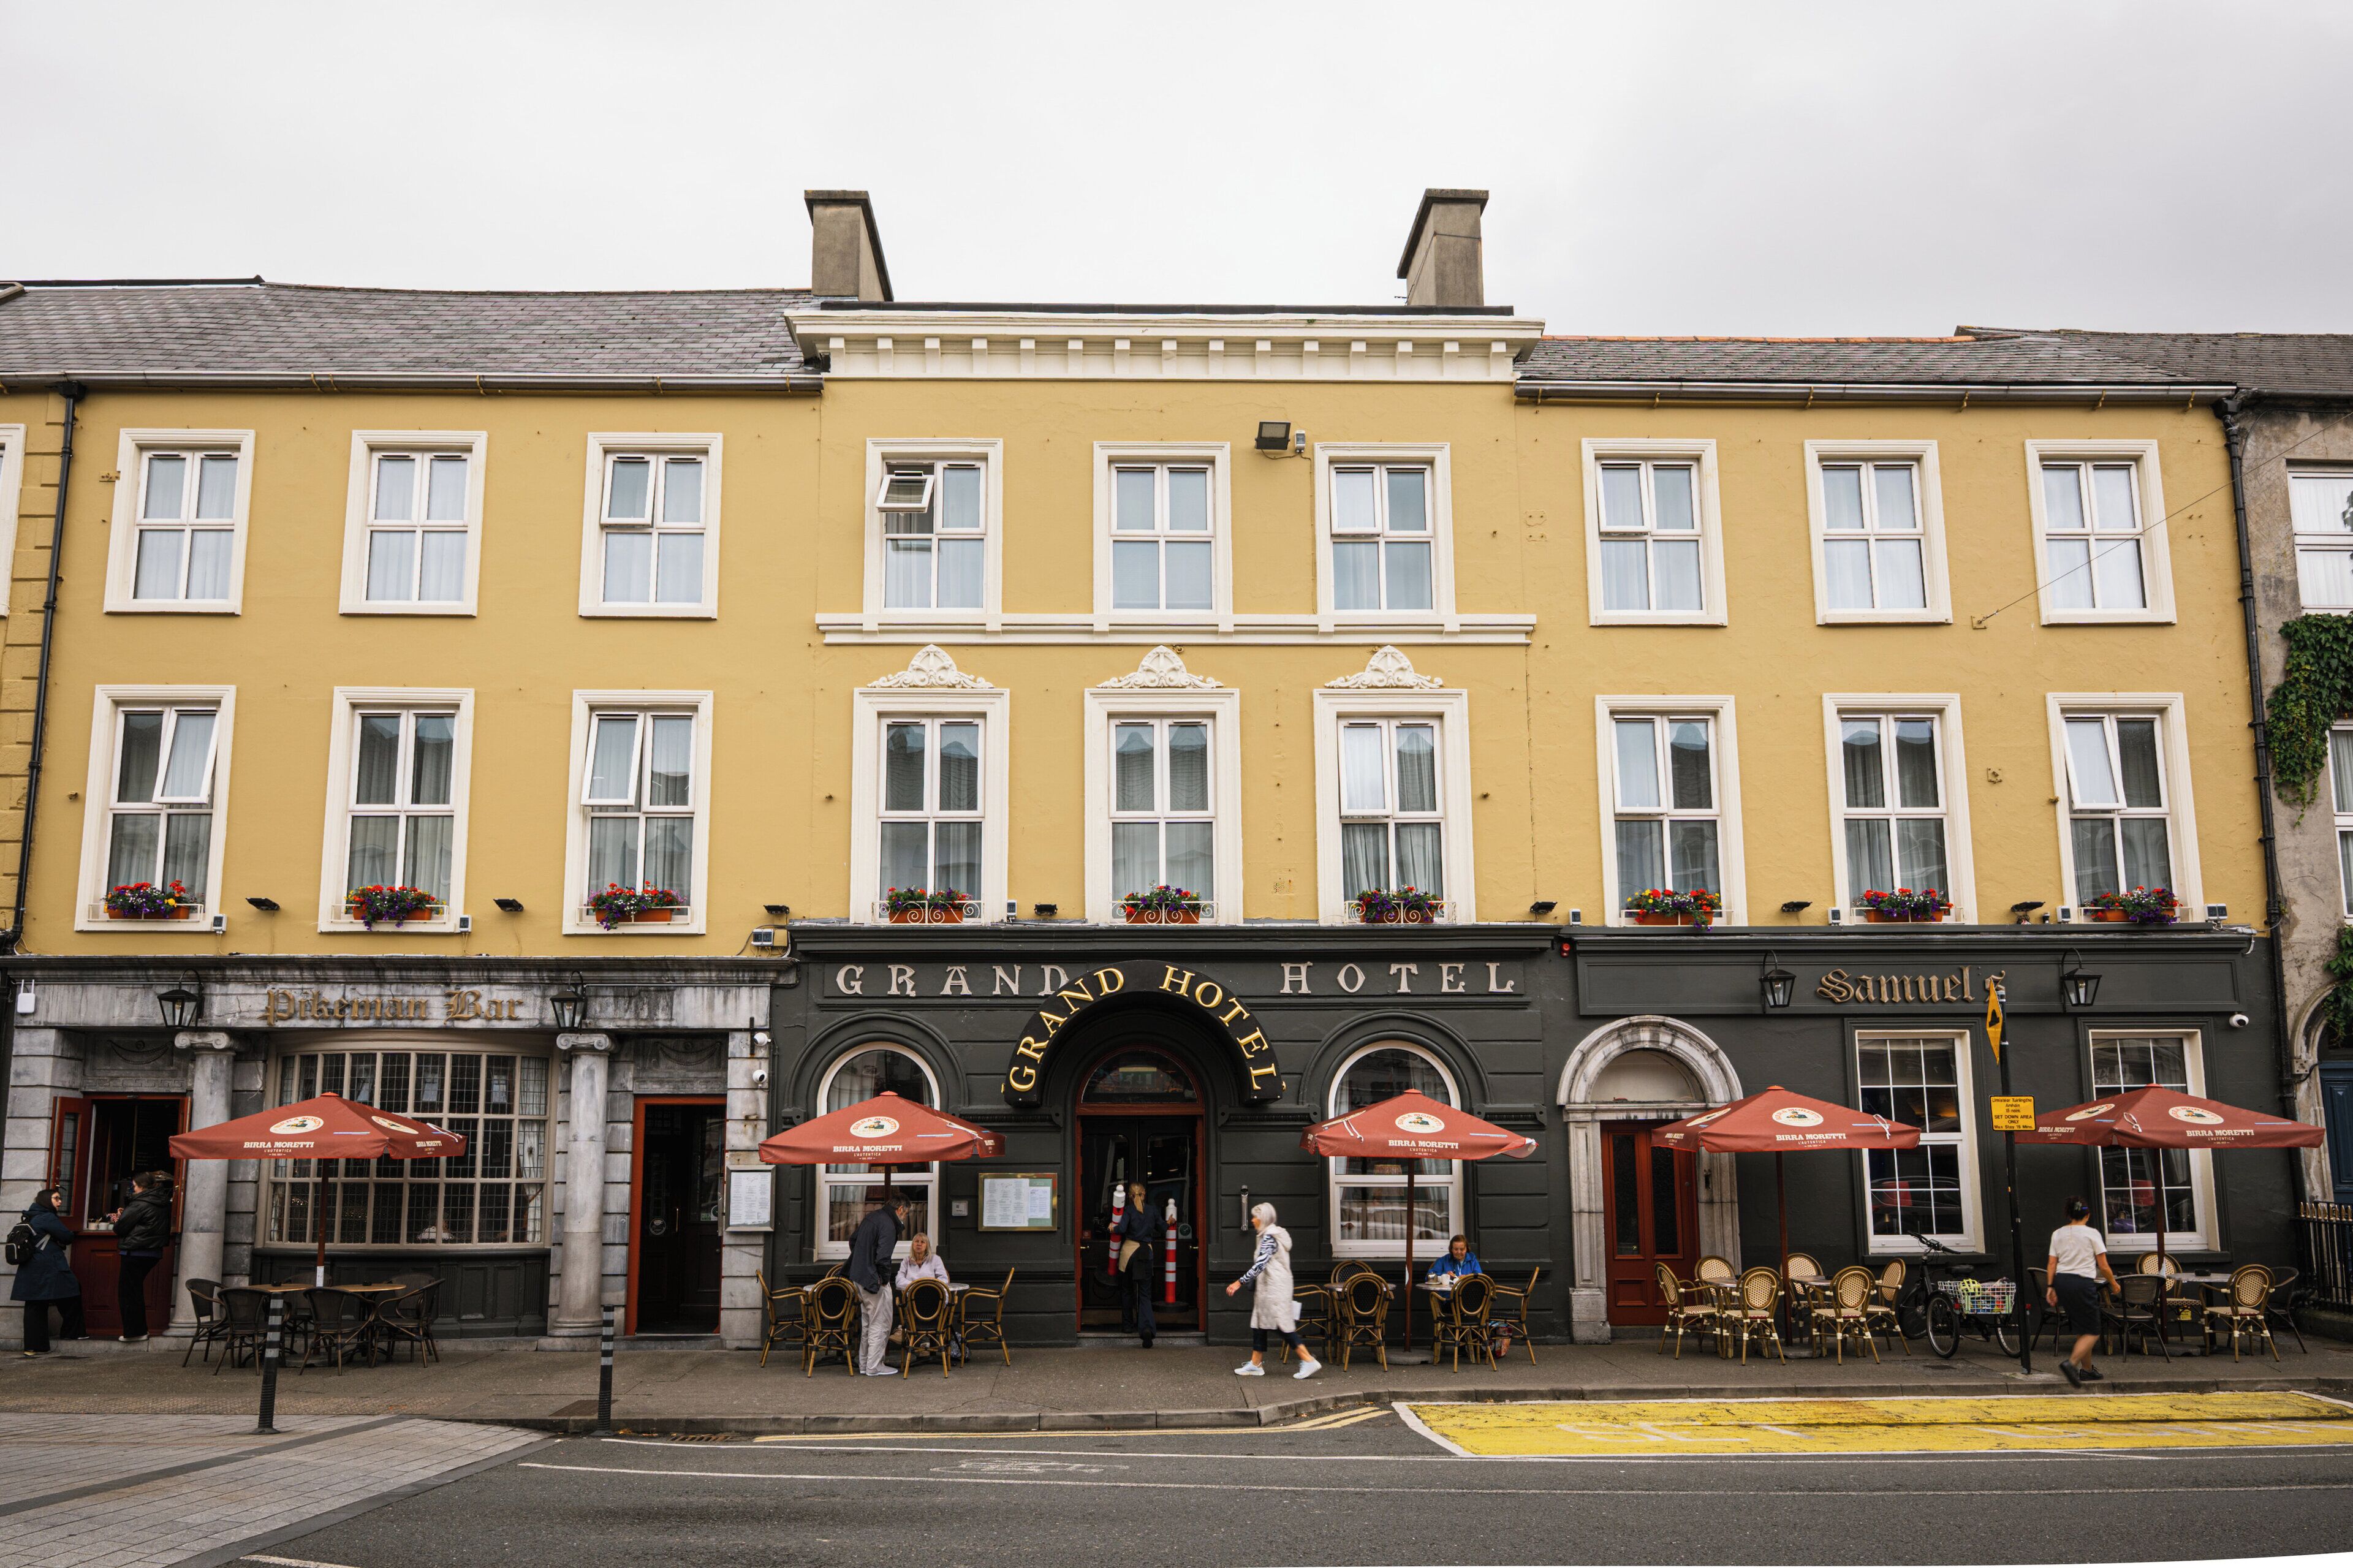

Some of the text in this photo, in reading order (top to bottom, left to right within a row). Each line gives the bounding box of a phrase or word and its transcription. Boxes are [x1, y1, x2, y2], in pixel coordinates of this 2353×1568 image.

[836, 961, 1514, 996] GRAND HOTEL
[257, 988, 525, 1026] Pikeman Bar
[1009, 965, 1276, 1093] GRAND HOTEL
[1419, 1140, 1458, 1149] MORETTI
